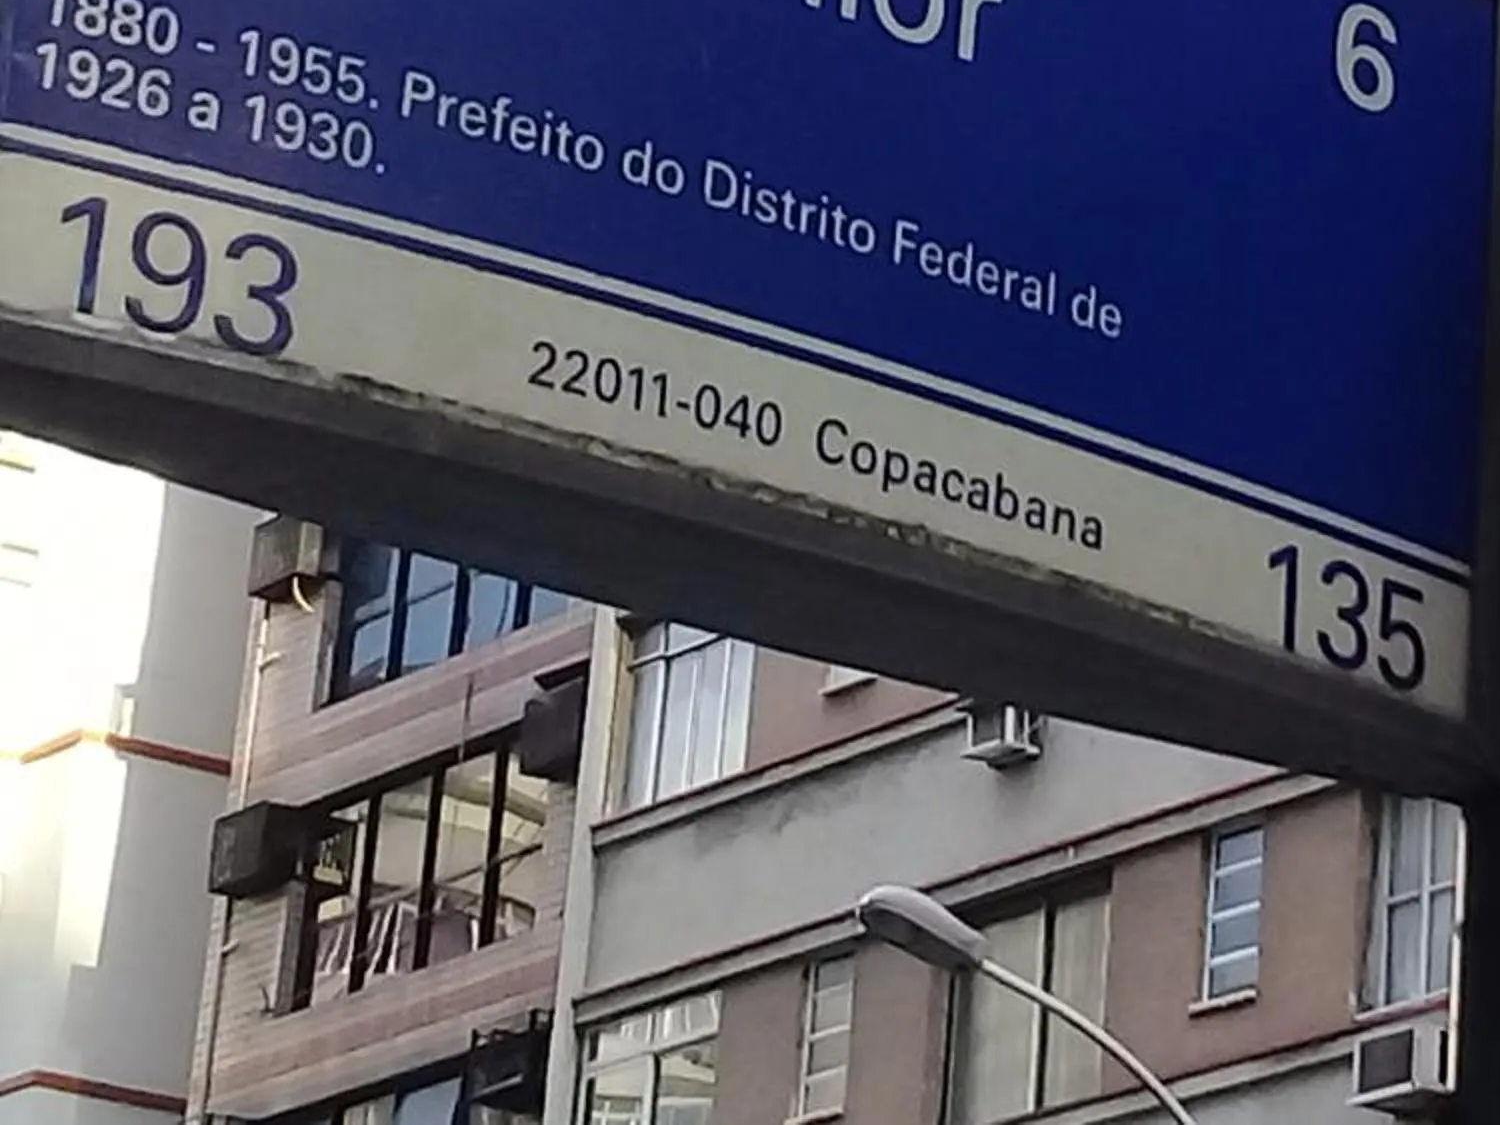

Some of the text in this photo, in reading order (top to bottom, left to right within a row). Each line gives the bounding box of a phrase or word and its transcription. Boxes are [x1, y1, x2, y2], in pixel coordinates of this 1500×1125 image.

[34, 42, 386, 175] 1926 a 1930.
[1335, 2, 1398, 112] 6
[239, 30, 379, 110] 1955.
[401, 71, 604, 172] Prefeito
[621, 141, 685, 197] do
[703, 159, 876, 255] Distrito
[893, 219, 1057, 316] Federal
[1070, 285, 1124, 339] de
[59, 195, 300, 358] 193
[527, 340, 1105, 551] 22011-040 Copacabana
[1268, 544, 1427, 692] 135
